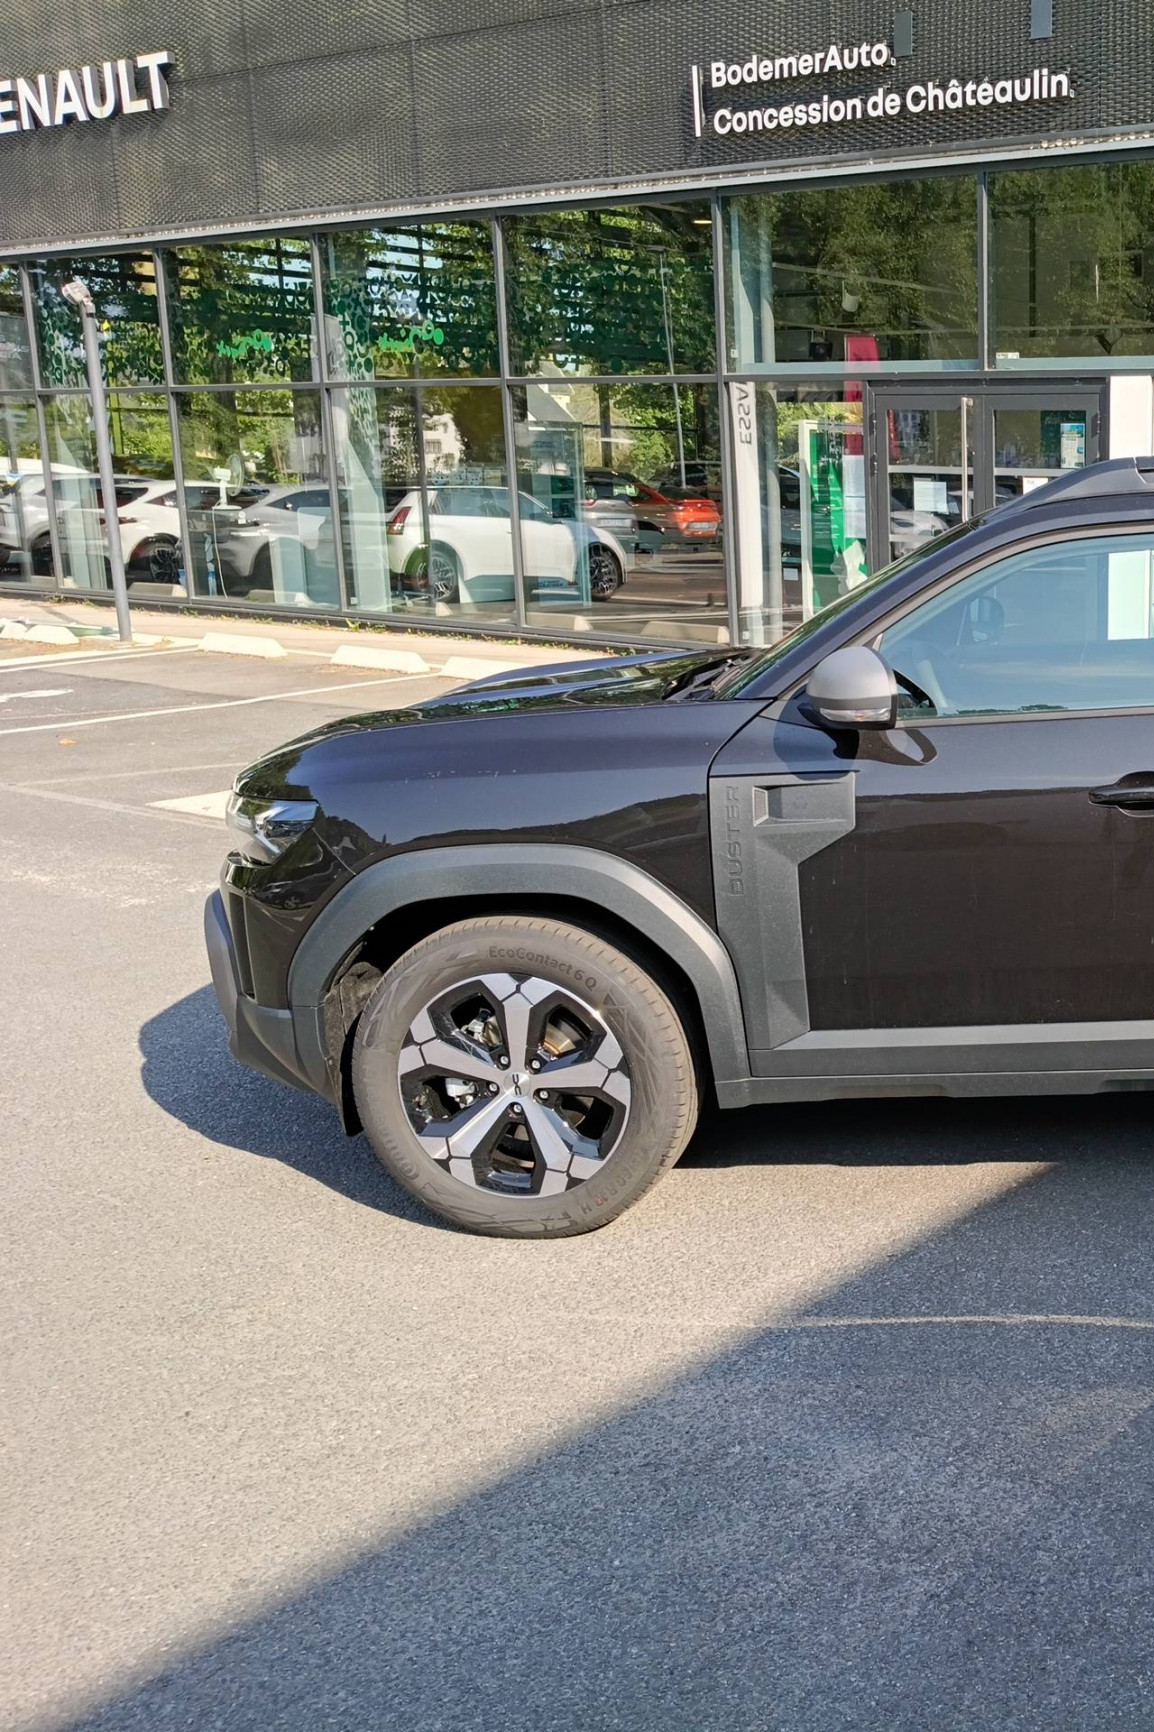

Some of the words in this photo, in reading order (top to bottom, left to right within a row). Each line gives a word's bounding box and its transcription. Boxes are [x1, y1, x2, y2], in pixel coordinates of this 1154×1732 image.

[0, 51, 175, 134] ENAULT
[714, 94, 862, 134] Concession
[867, 87, 900, 117] de
[725, 786, 744, 897] DUSTER
[488, 946, 573, 975] EcoContact
[574, 970, 585, 980] 6
[585, 977, 597, 991] Q
